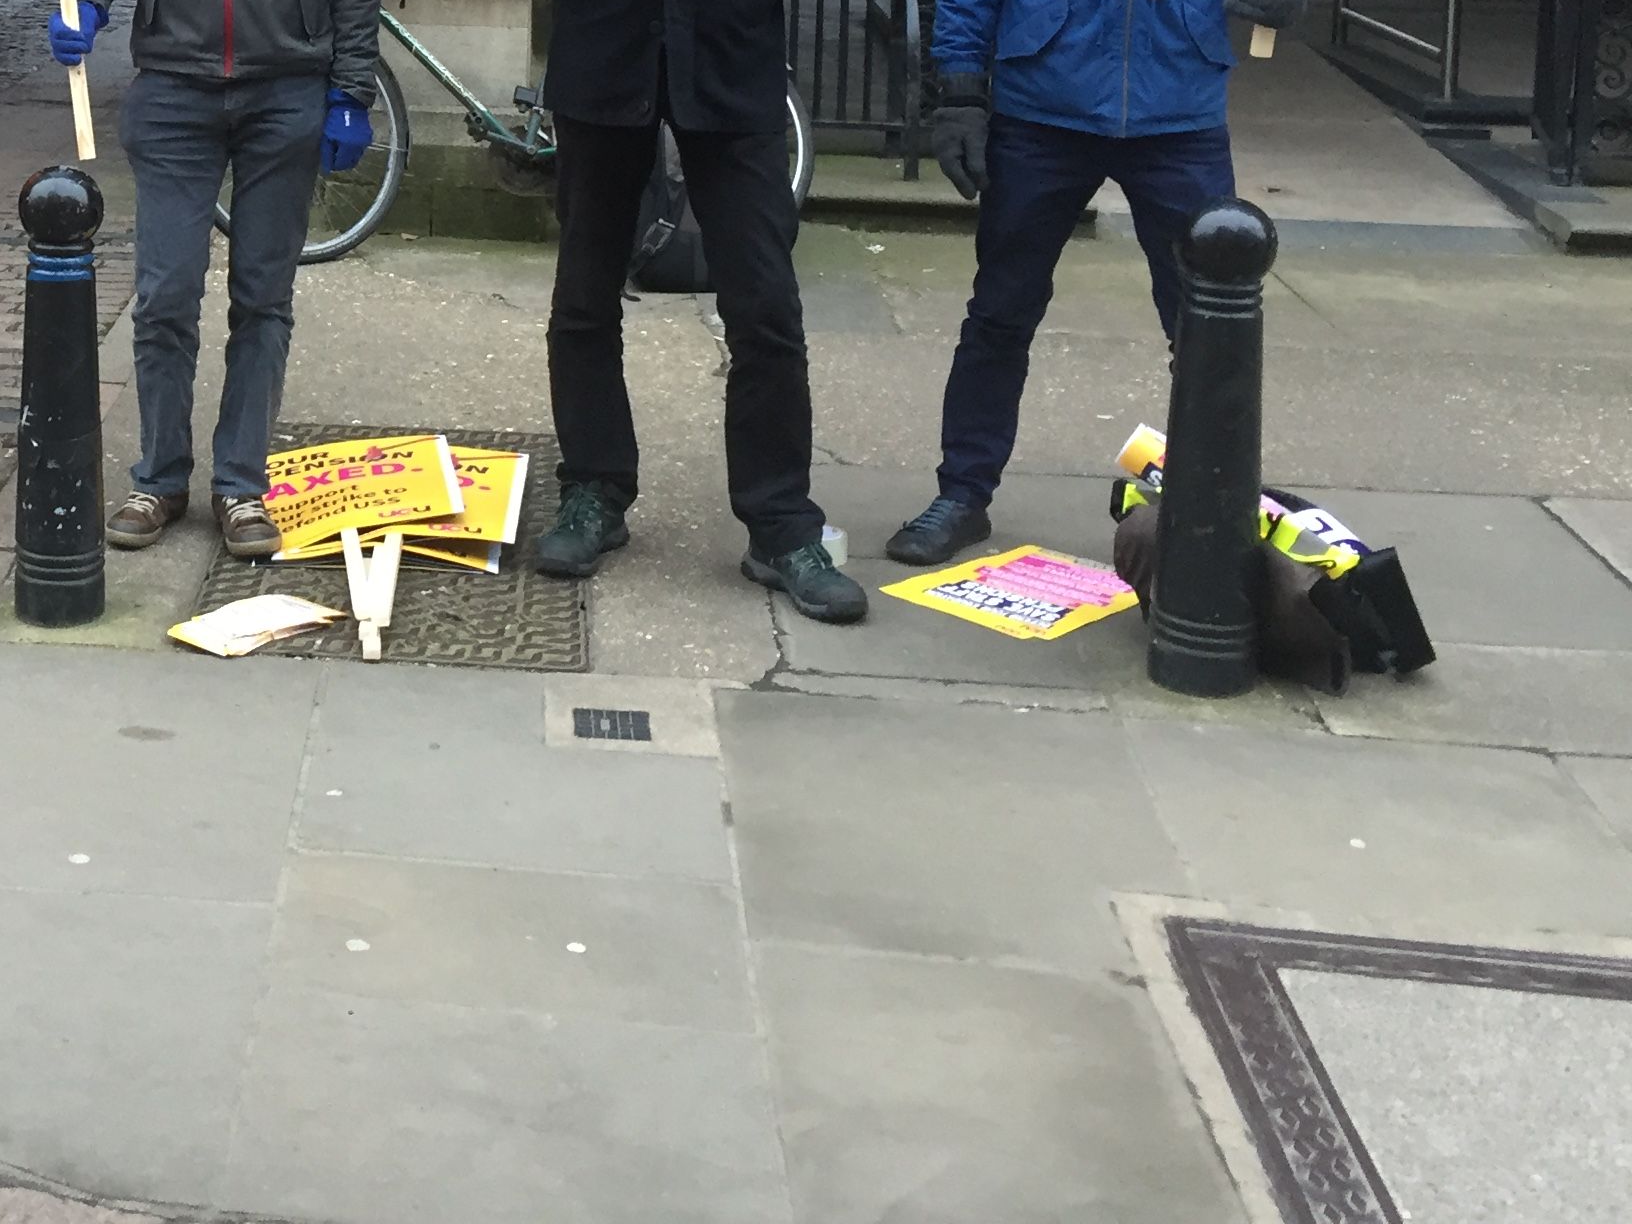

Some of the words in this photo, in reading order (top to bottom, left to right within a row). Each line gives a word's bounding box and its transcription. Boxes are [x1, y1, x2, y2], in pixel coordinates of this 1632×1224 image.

[267, 451, 329, 469] OUR
[264, 463, 423, 501] AXED.
[282, 505, 346, 534] efend
[354, 496, 401, 510] USS
[311, 491, 376, 512] strike
[384, 486, 408, 496] to
